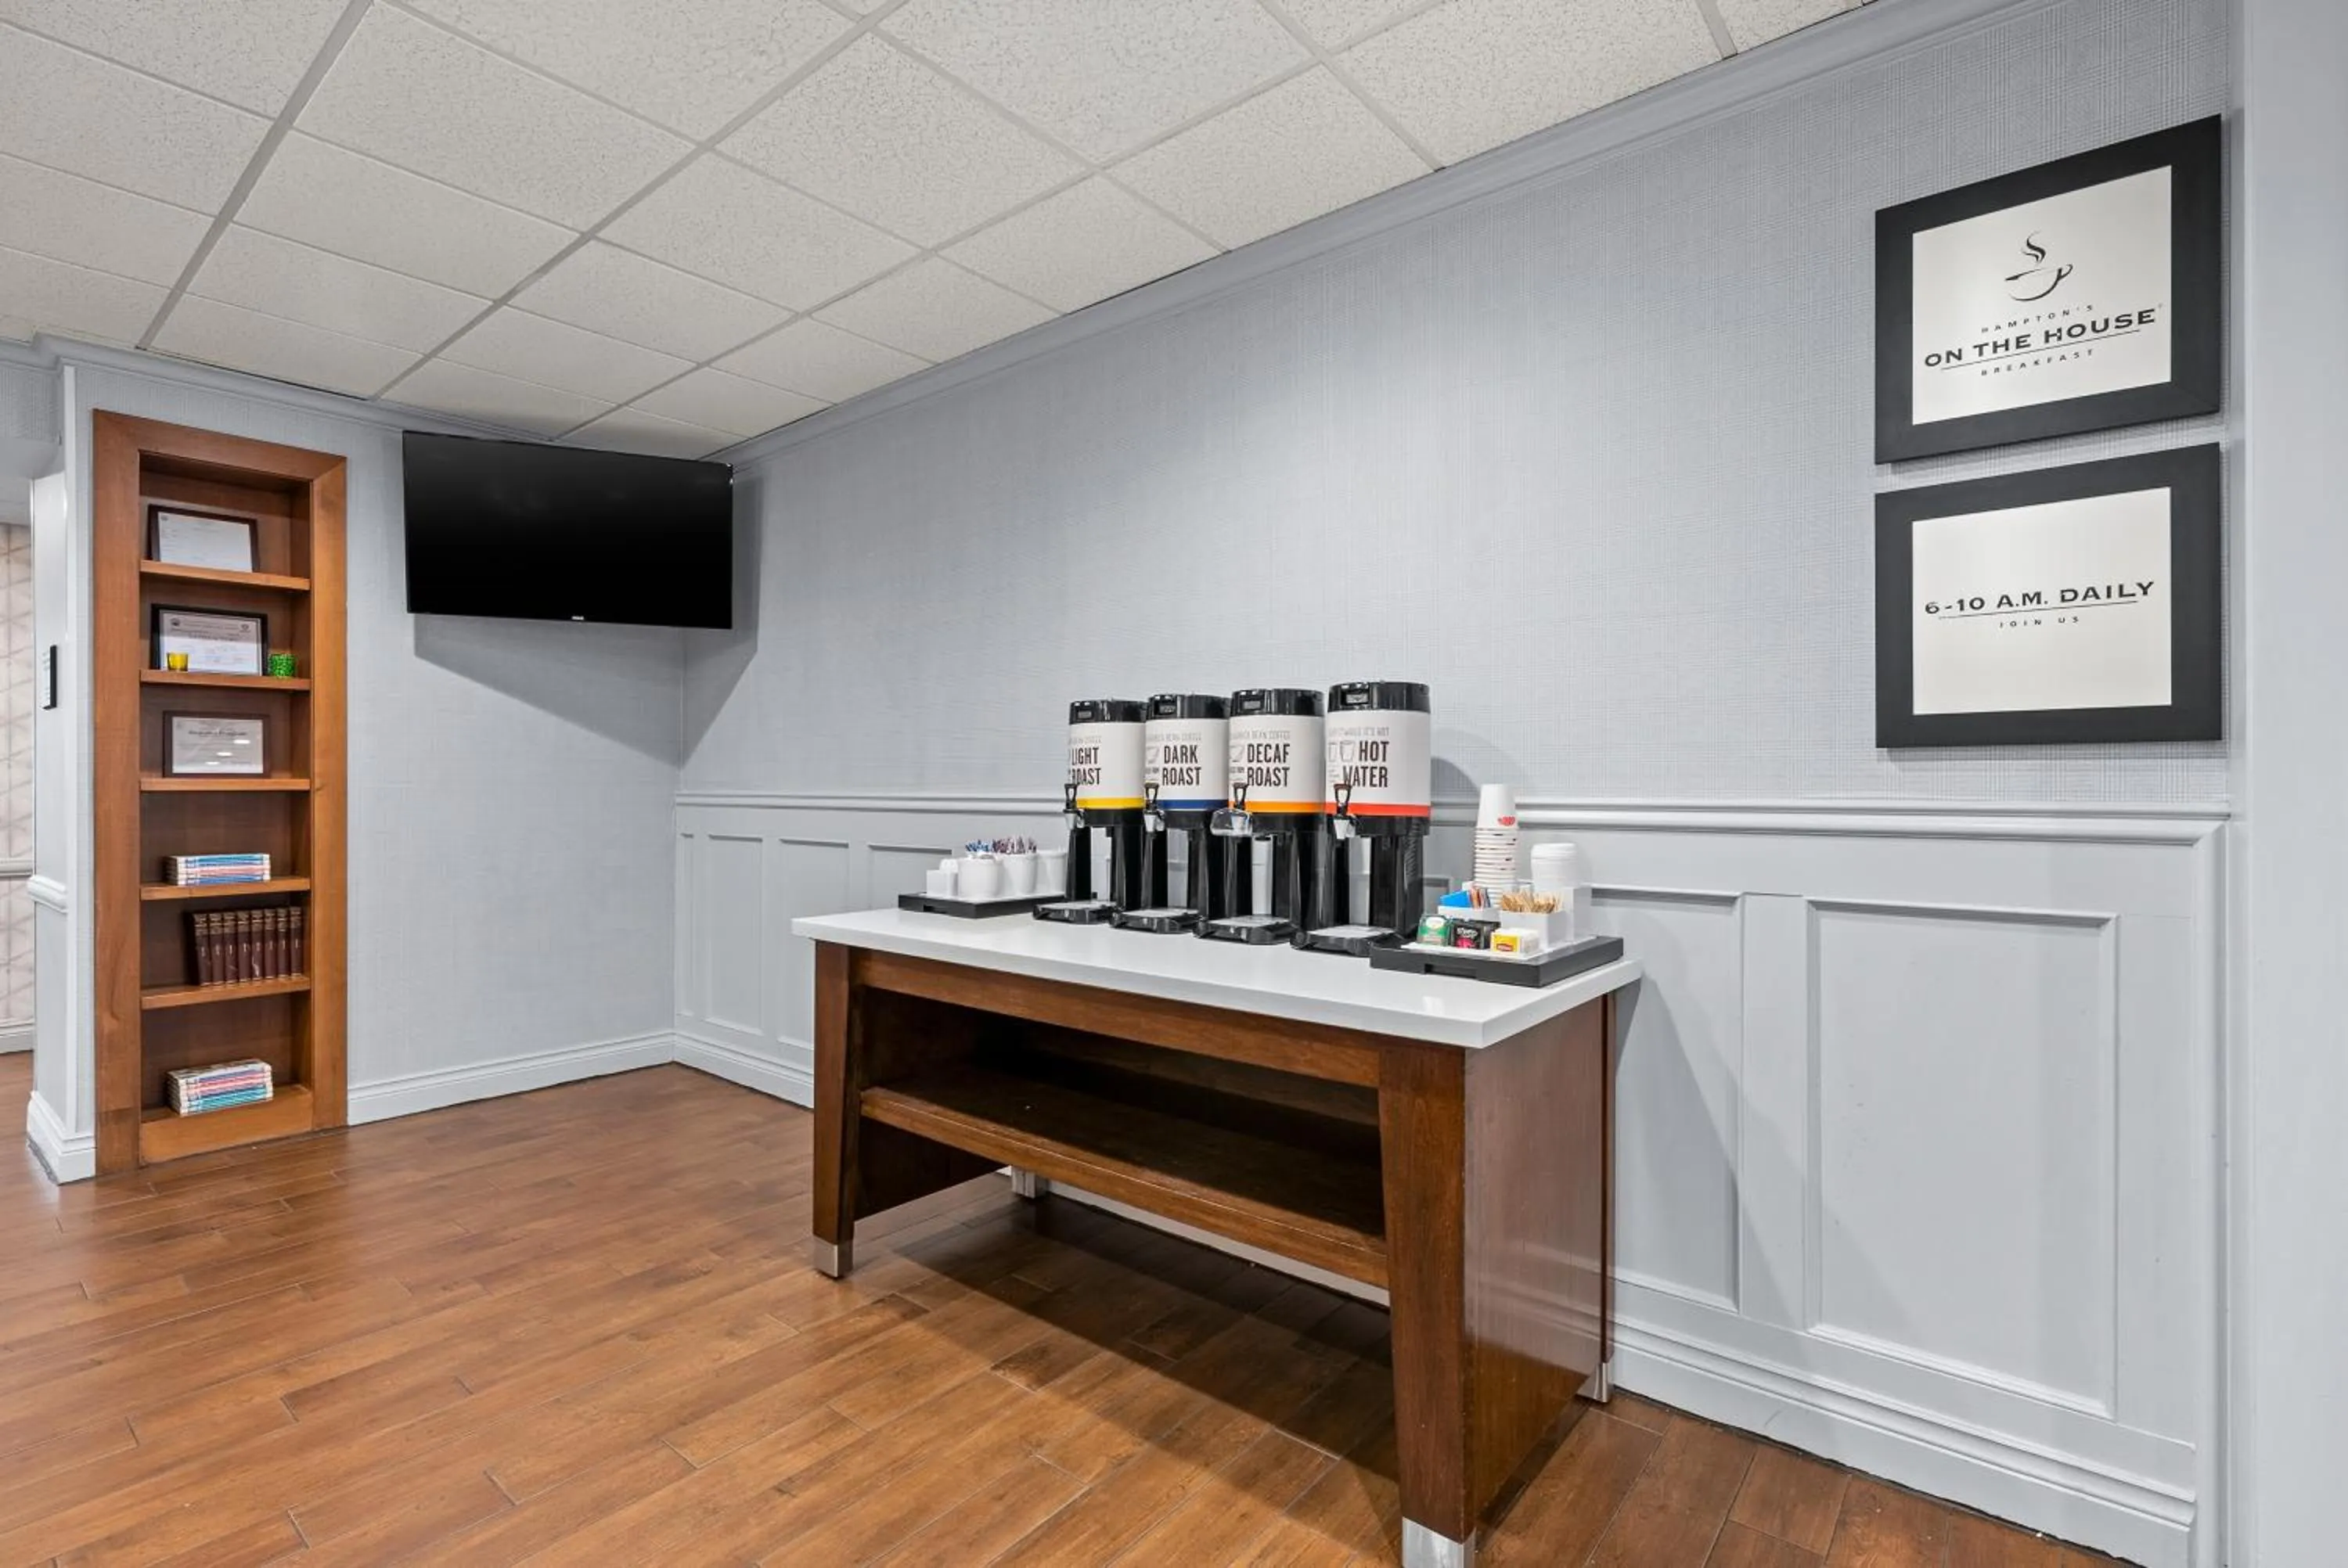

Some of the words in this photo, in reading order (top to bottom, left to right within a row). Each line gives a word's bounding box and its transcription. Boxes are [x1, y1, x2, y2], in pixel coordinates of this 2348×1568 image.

[1981, 304, 2094, 333] HAMPTON'S
[1924, 347, 1963, 367] ON
[1972, 333, 2032, 358] THE
[2043, 307, 2156, 344] HOUSE
[1981, 348, 2094, 376] BREAKFAST
[1924, 596, 1986, 615] 6-10
[1996, 591, 2049, 609] A.M.
[2059, 581, 2155, 603] DAILY
[1999, 618, 2043, 628] JOIN
[2058, 615, 2080, 624] US
[1071, 746, 1100, 766] LIGHT
[1163, 744, 1199, 764] DARK
[1247, 743, 1291, 763] DECAF
[1358, 740, 1389, 762] HOT
[1161, 766, 1202, 786] ROAST
[1247, 766, 1291, 787] ROAST
